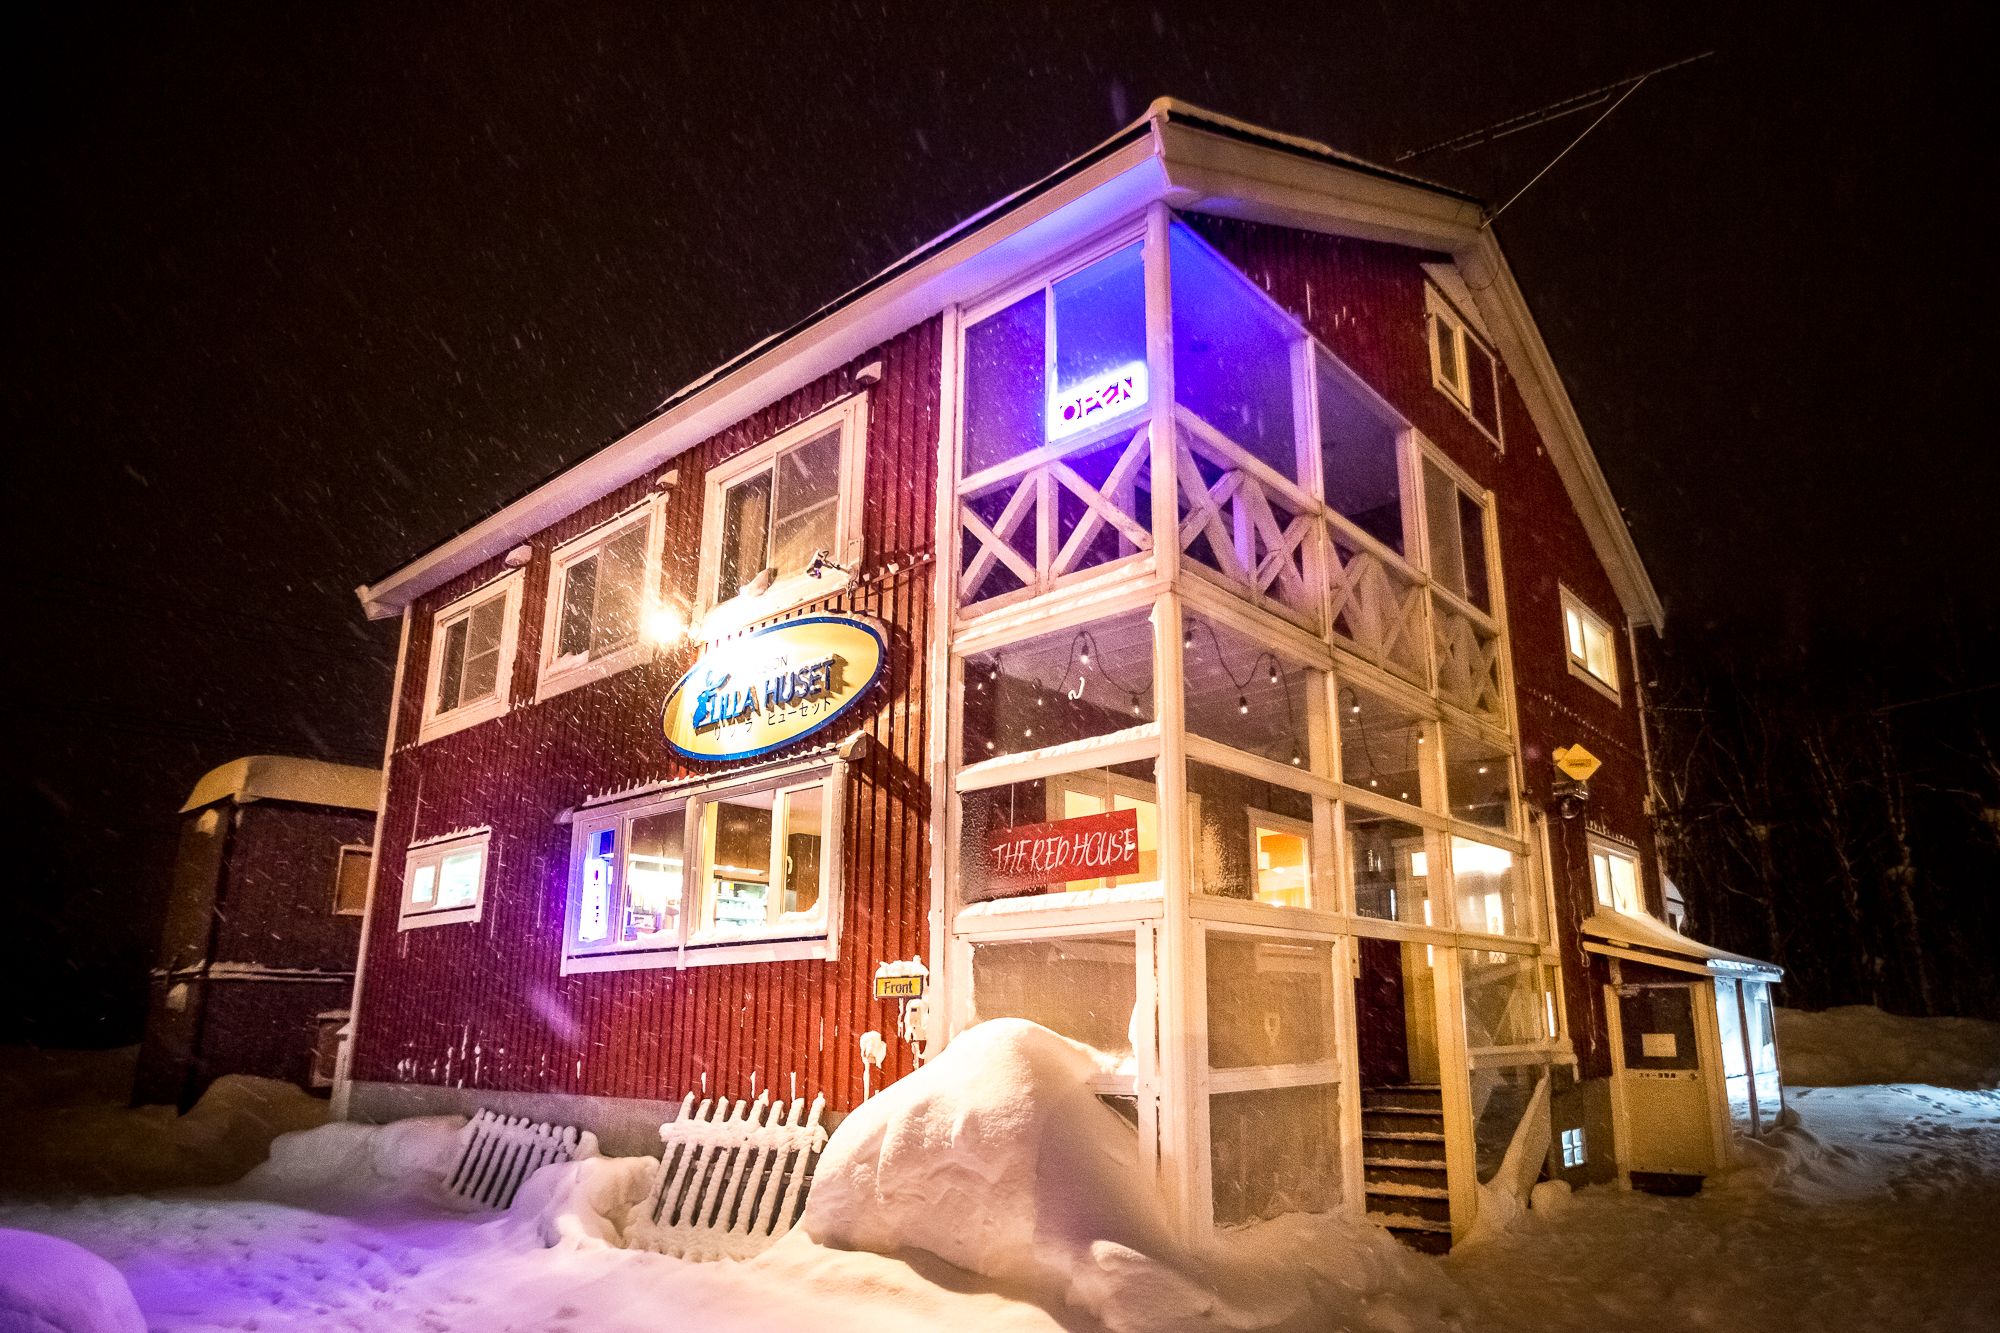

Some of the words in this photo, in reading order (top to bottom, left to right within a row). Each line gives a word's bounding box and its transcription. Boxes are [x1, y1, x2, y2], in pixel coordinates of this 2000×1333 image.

[1058, 373, 1138, 428] OPEN
[707, 685, 757, 725] LILLA
[764, 658, 836, 708] HUSET
[767, 696, 831, 726] ヒューセット
[991, 839, 1031, 874] THE
[1030, 834, 1070, 872] RED
[1070, 827, 1137, 867] HOUSE
[884, 980, 913, 994] Front
